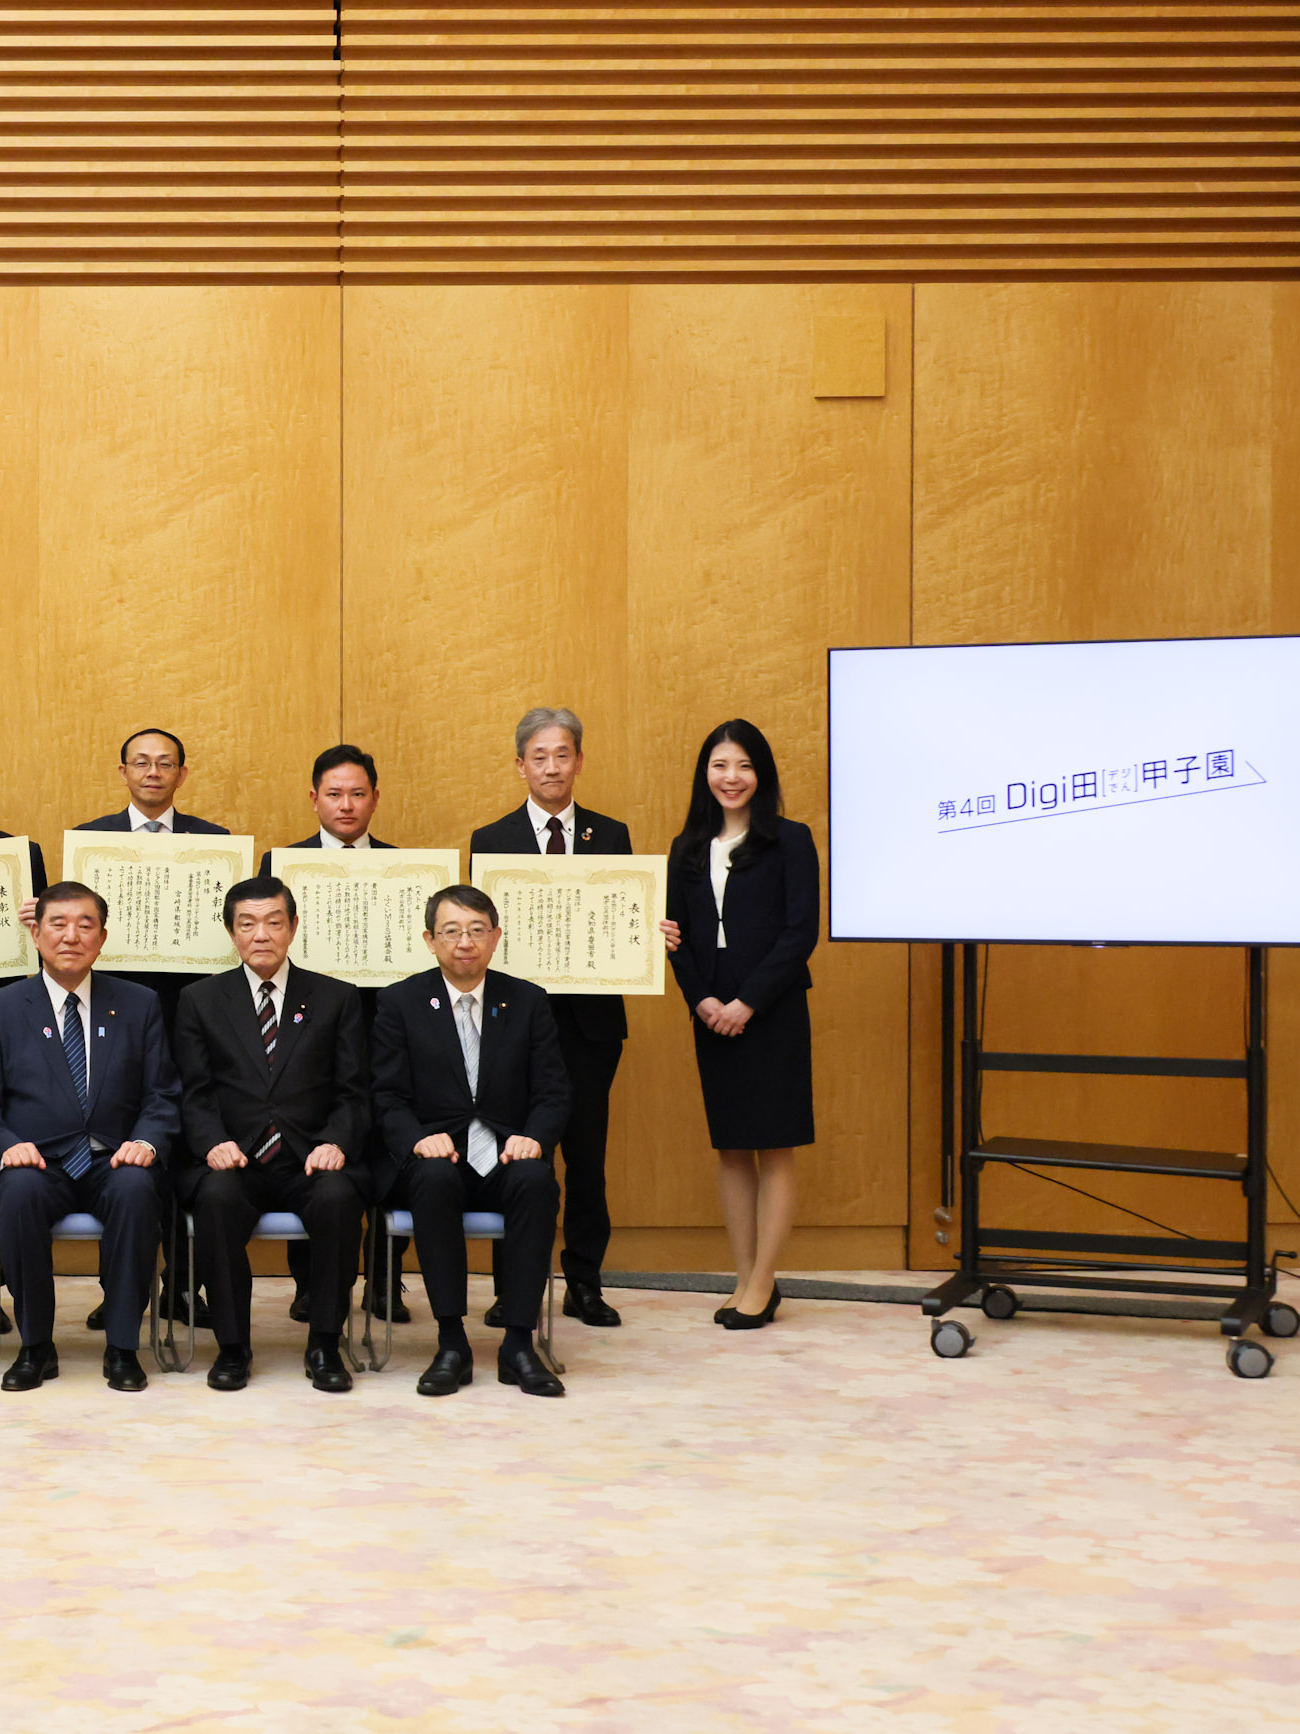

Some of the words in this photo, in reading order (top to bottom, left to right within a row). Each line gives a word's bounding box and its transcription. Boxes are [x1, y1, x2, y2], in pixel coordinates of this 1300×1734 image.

[938, 795, 995, 820] 第4回
[212, 880, 223, 923] 表彰状
[628, 903, 640, 946] 表彰状
